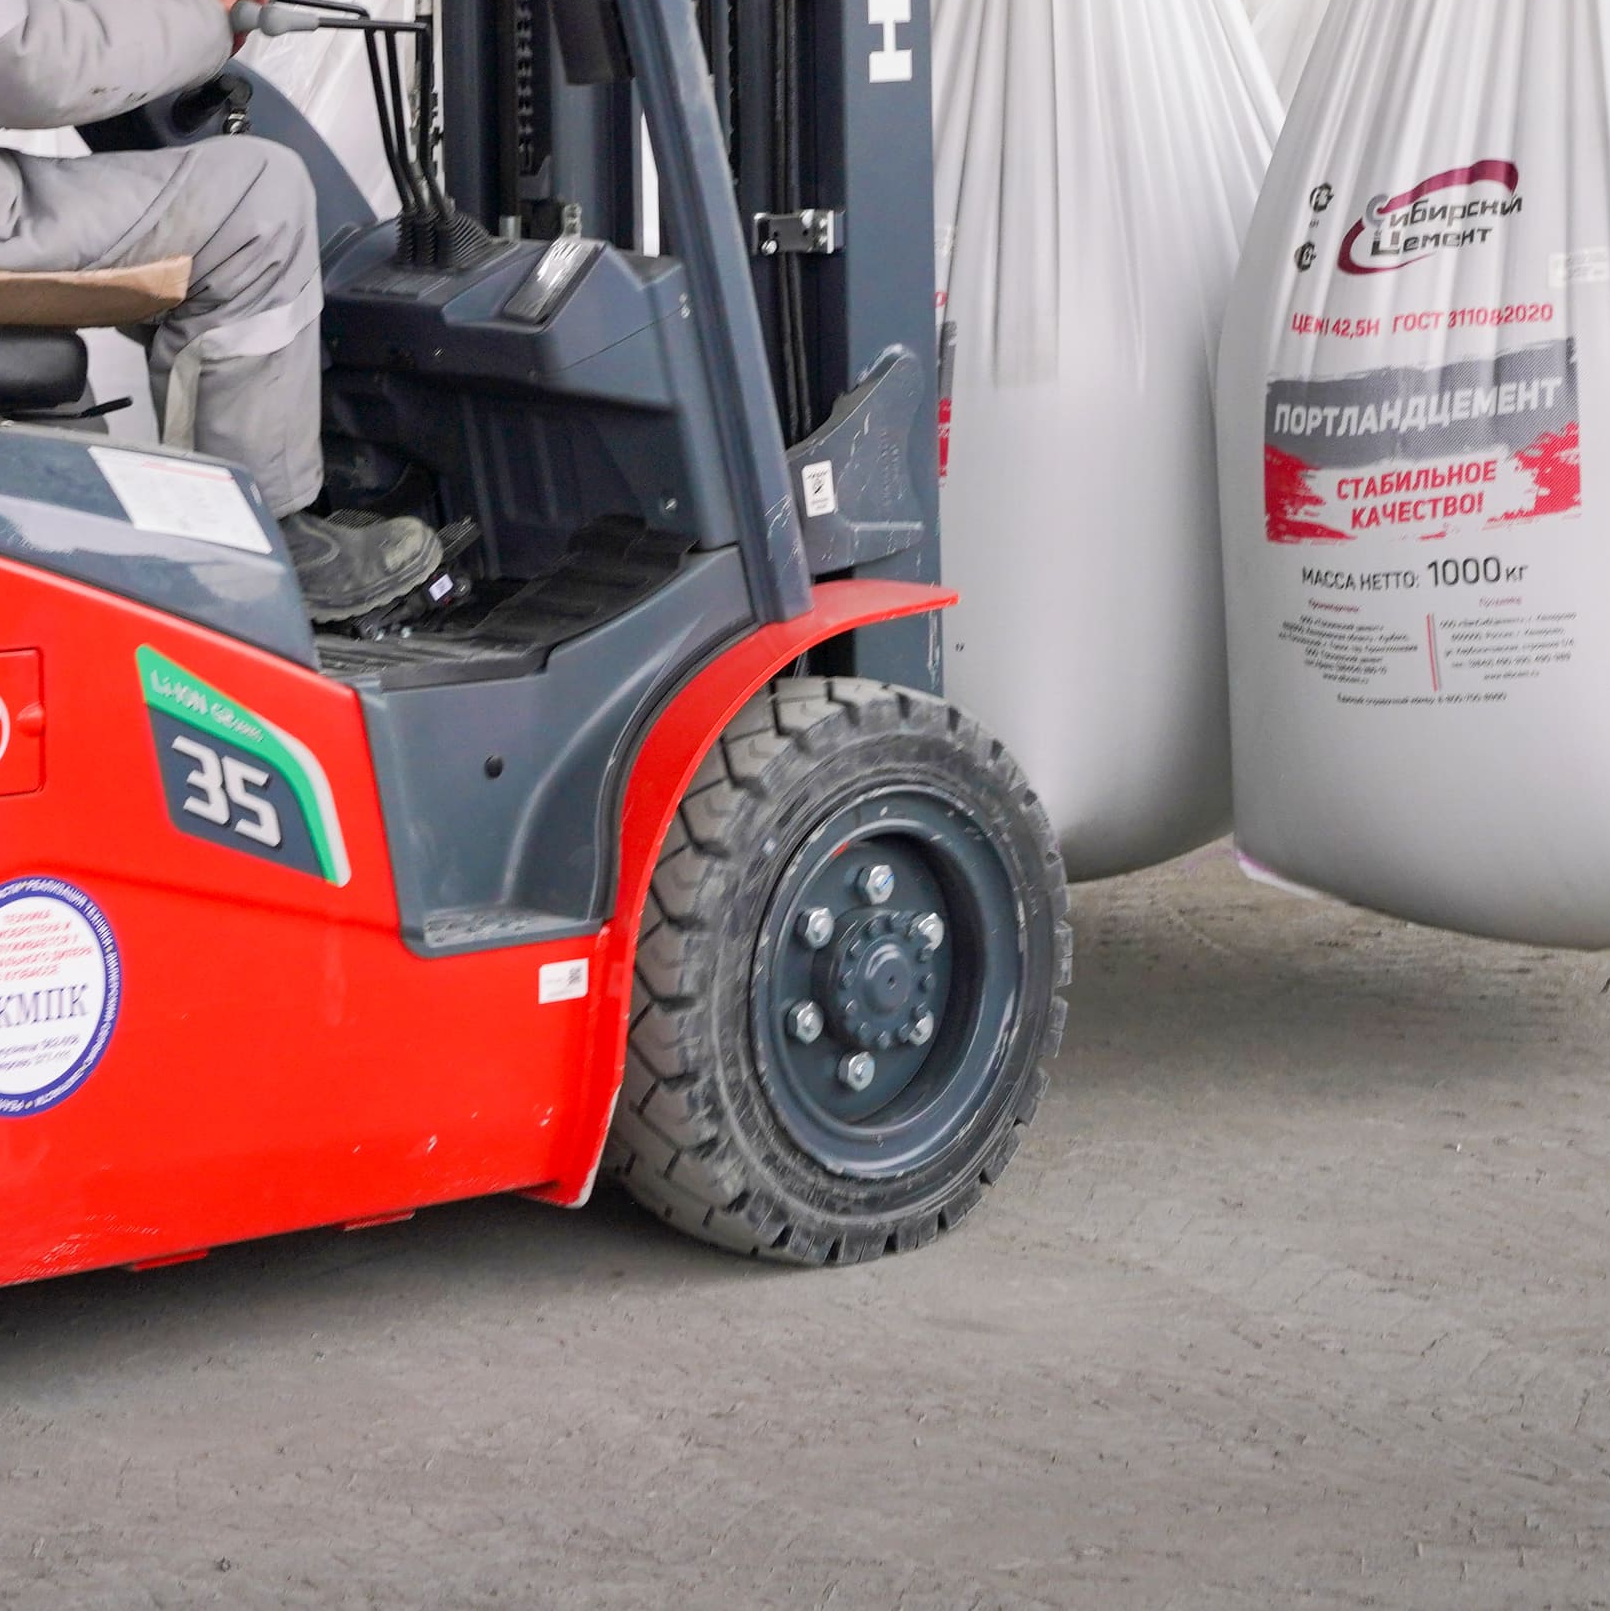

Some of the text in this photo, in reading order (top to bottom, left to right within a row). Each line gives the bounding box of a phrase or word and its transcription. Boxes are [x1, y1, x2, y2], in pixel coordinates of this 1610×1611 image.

[1370, 226, 1494, 256] Цемент
[1332, 317, 1380, 340] 42,5Н
[1392, 311, 1443, 334] ГОСТ
[1274, 377, 1563, 438] ПОРТЛАНДЦЕМЕНТ
[1336, 459, 1499, 501] СТАБИЛЬНОЕ
[1350, 491, 1485, 531] КАЧЕСТВО!
[1301, 555, 1529, 592] МАССА НЕТТО: 1000 кг
[171, 734, 282, 848] 35
